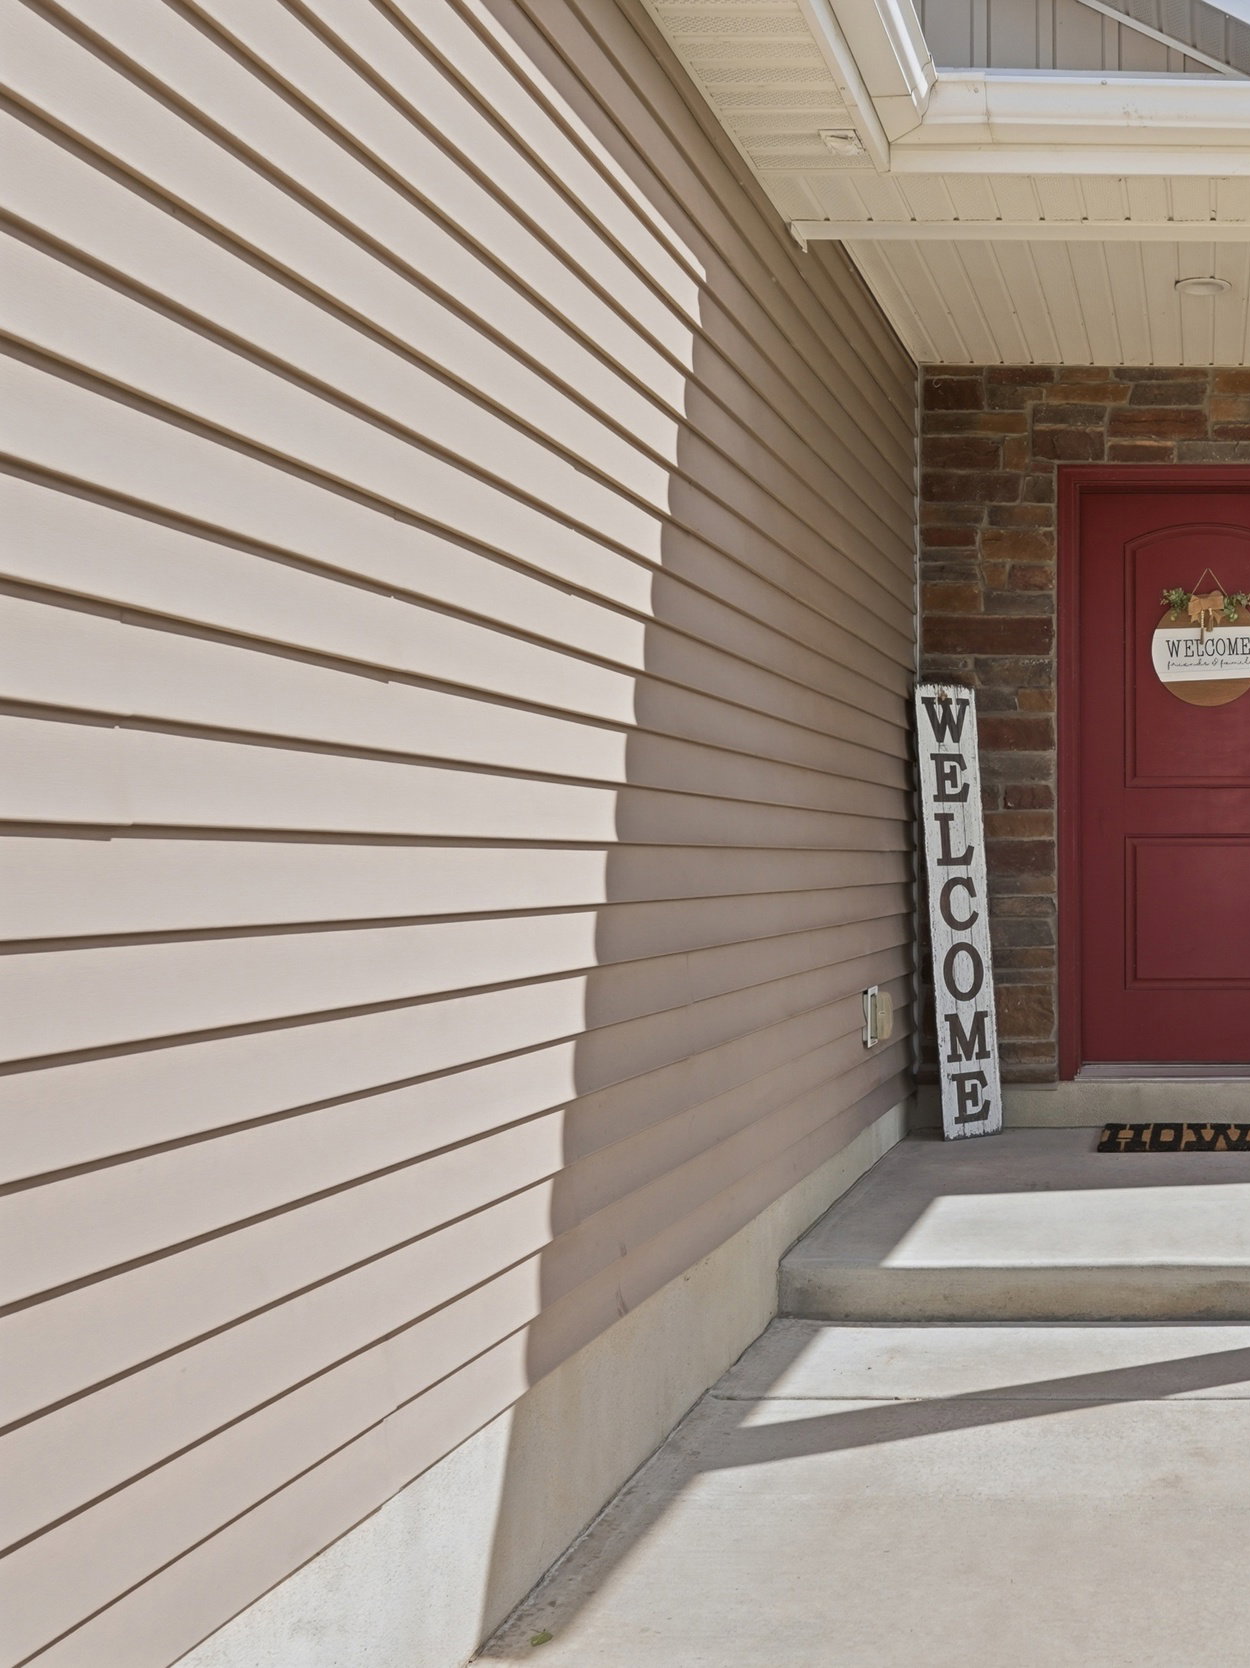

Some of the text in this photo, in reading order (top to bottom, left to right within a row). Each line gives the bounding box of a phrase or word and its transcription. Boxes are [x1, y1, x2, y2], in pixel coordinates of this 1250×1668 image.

[1166, 637, 1250, 658] WELCOME
[1168, 659, 1210, 670] friends
[921, 695, 991, 1125] WELCOME
